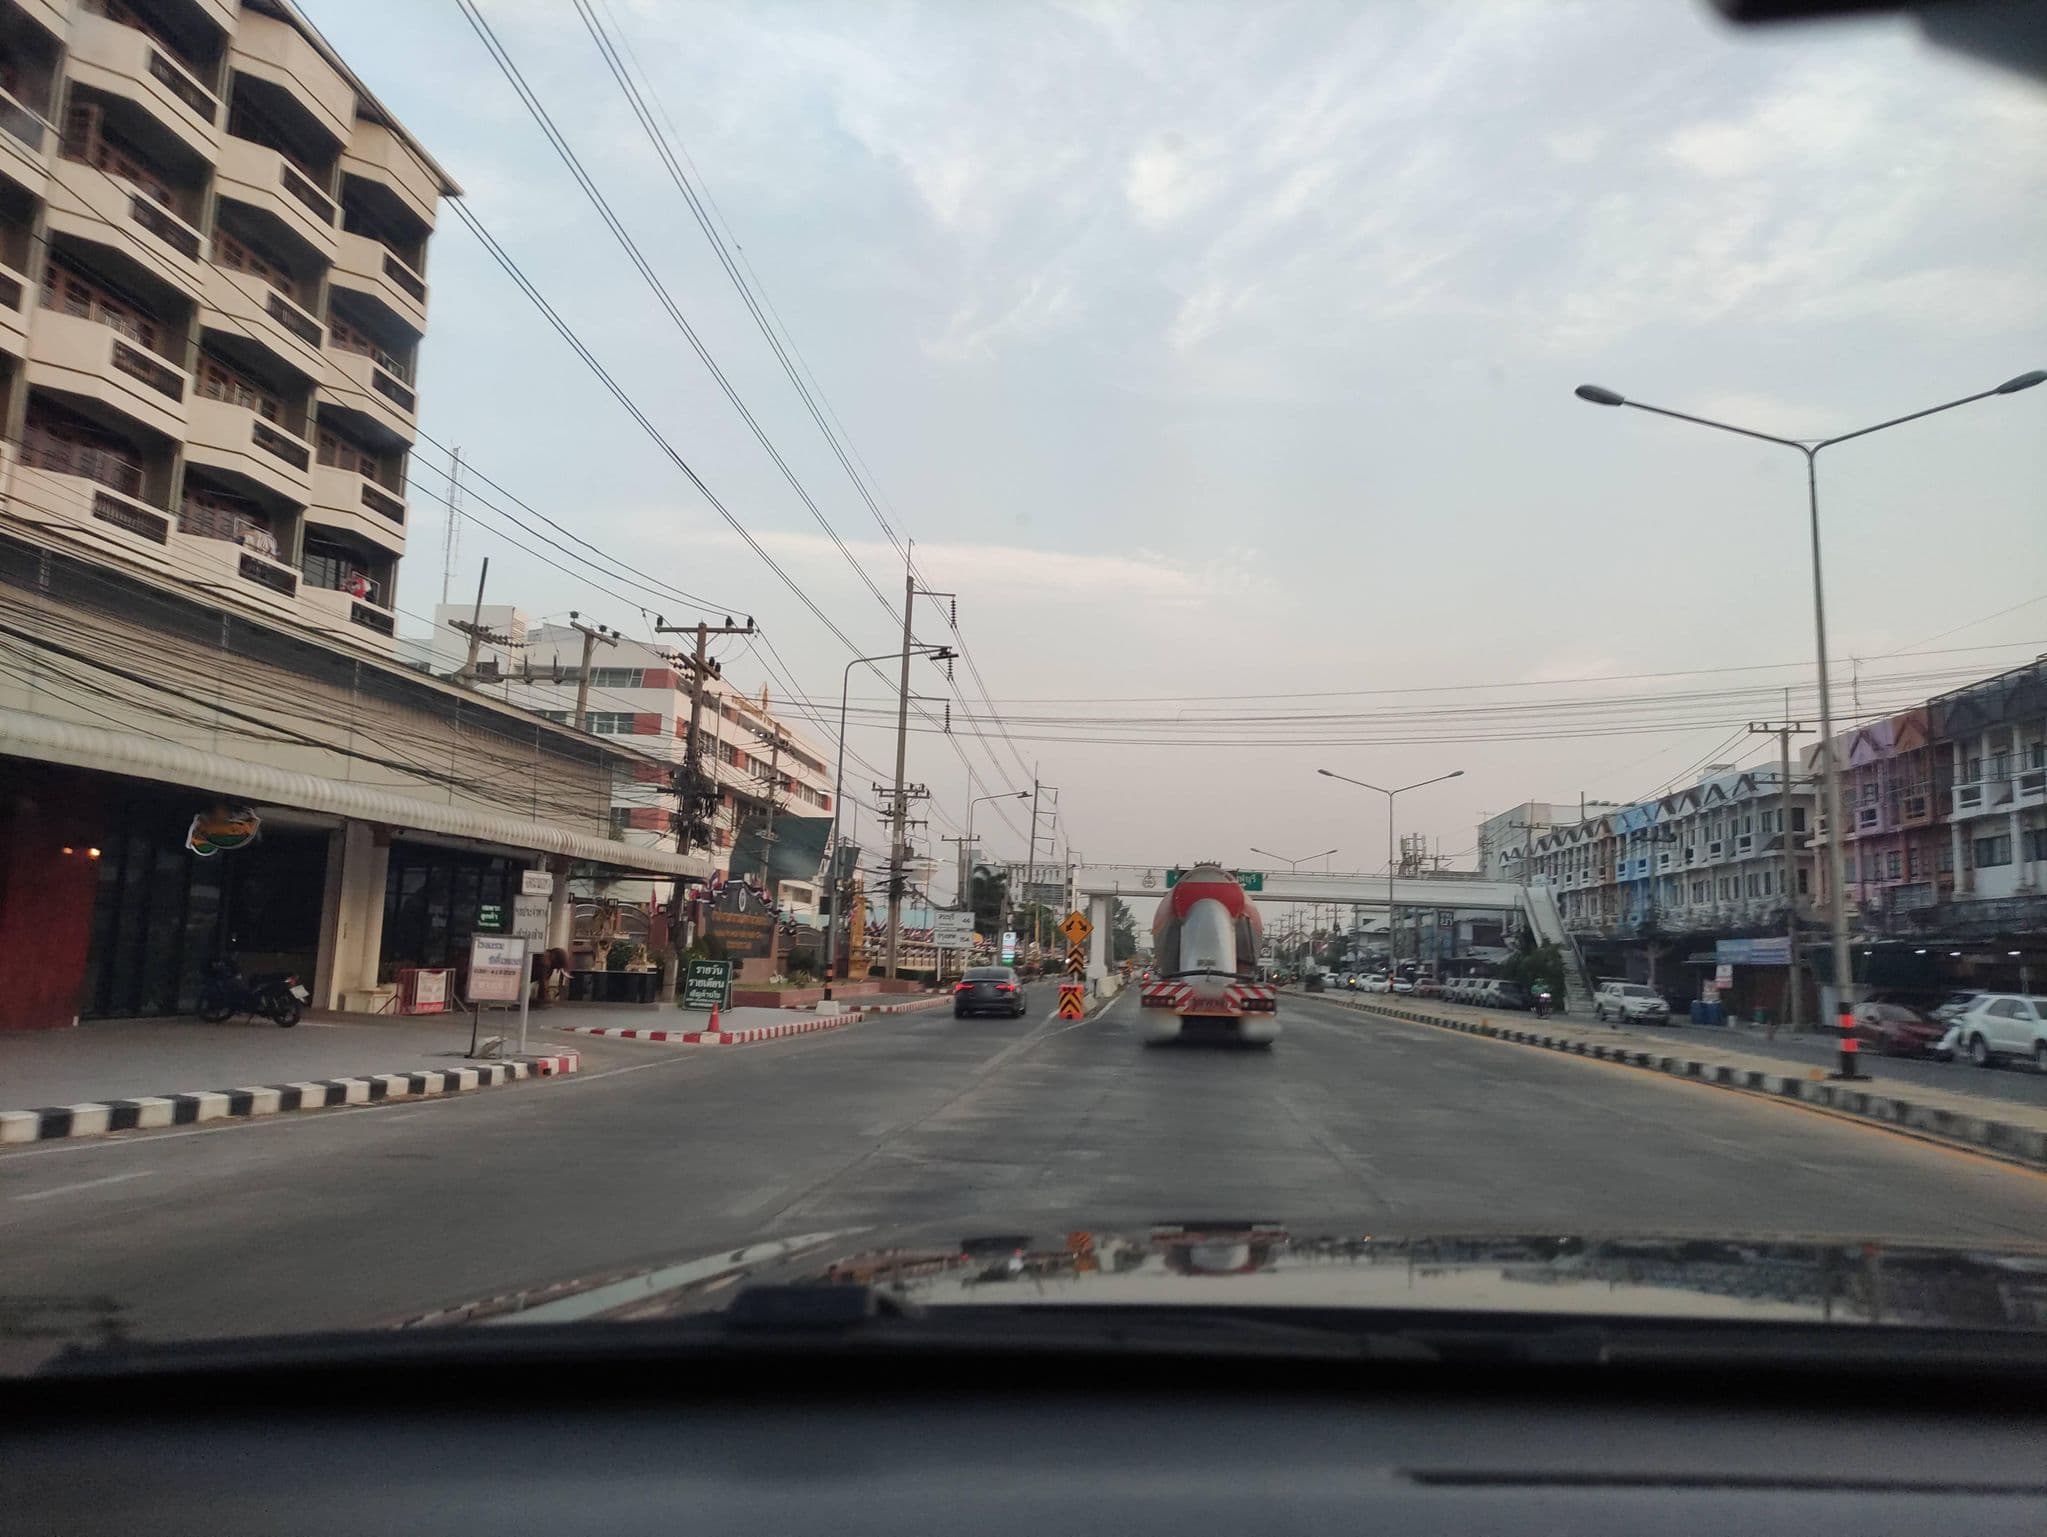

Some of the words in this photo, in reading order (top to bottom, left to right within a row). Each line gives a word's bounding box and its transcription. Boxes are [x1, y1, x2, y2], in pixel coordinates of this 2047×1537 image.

[695, 964, 723, 976] รายวัน
[688, 977, 725, 989] รายเดือน
